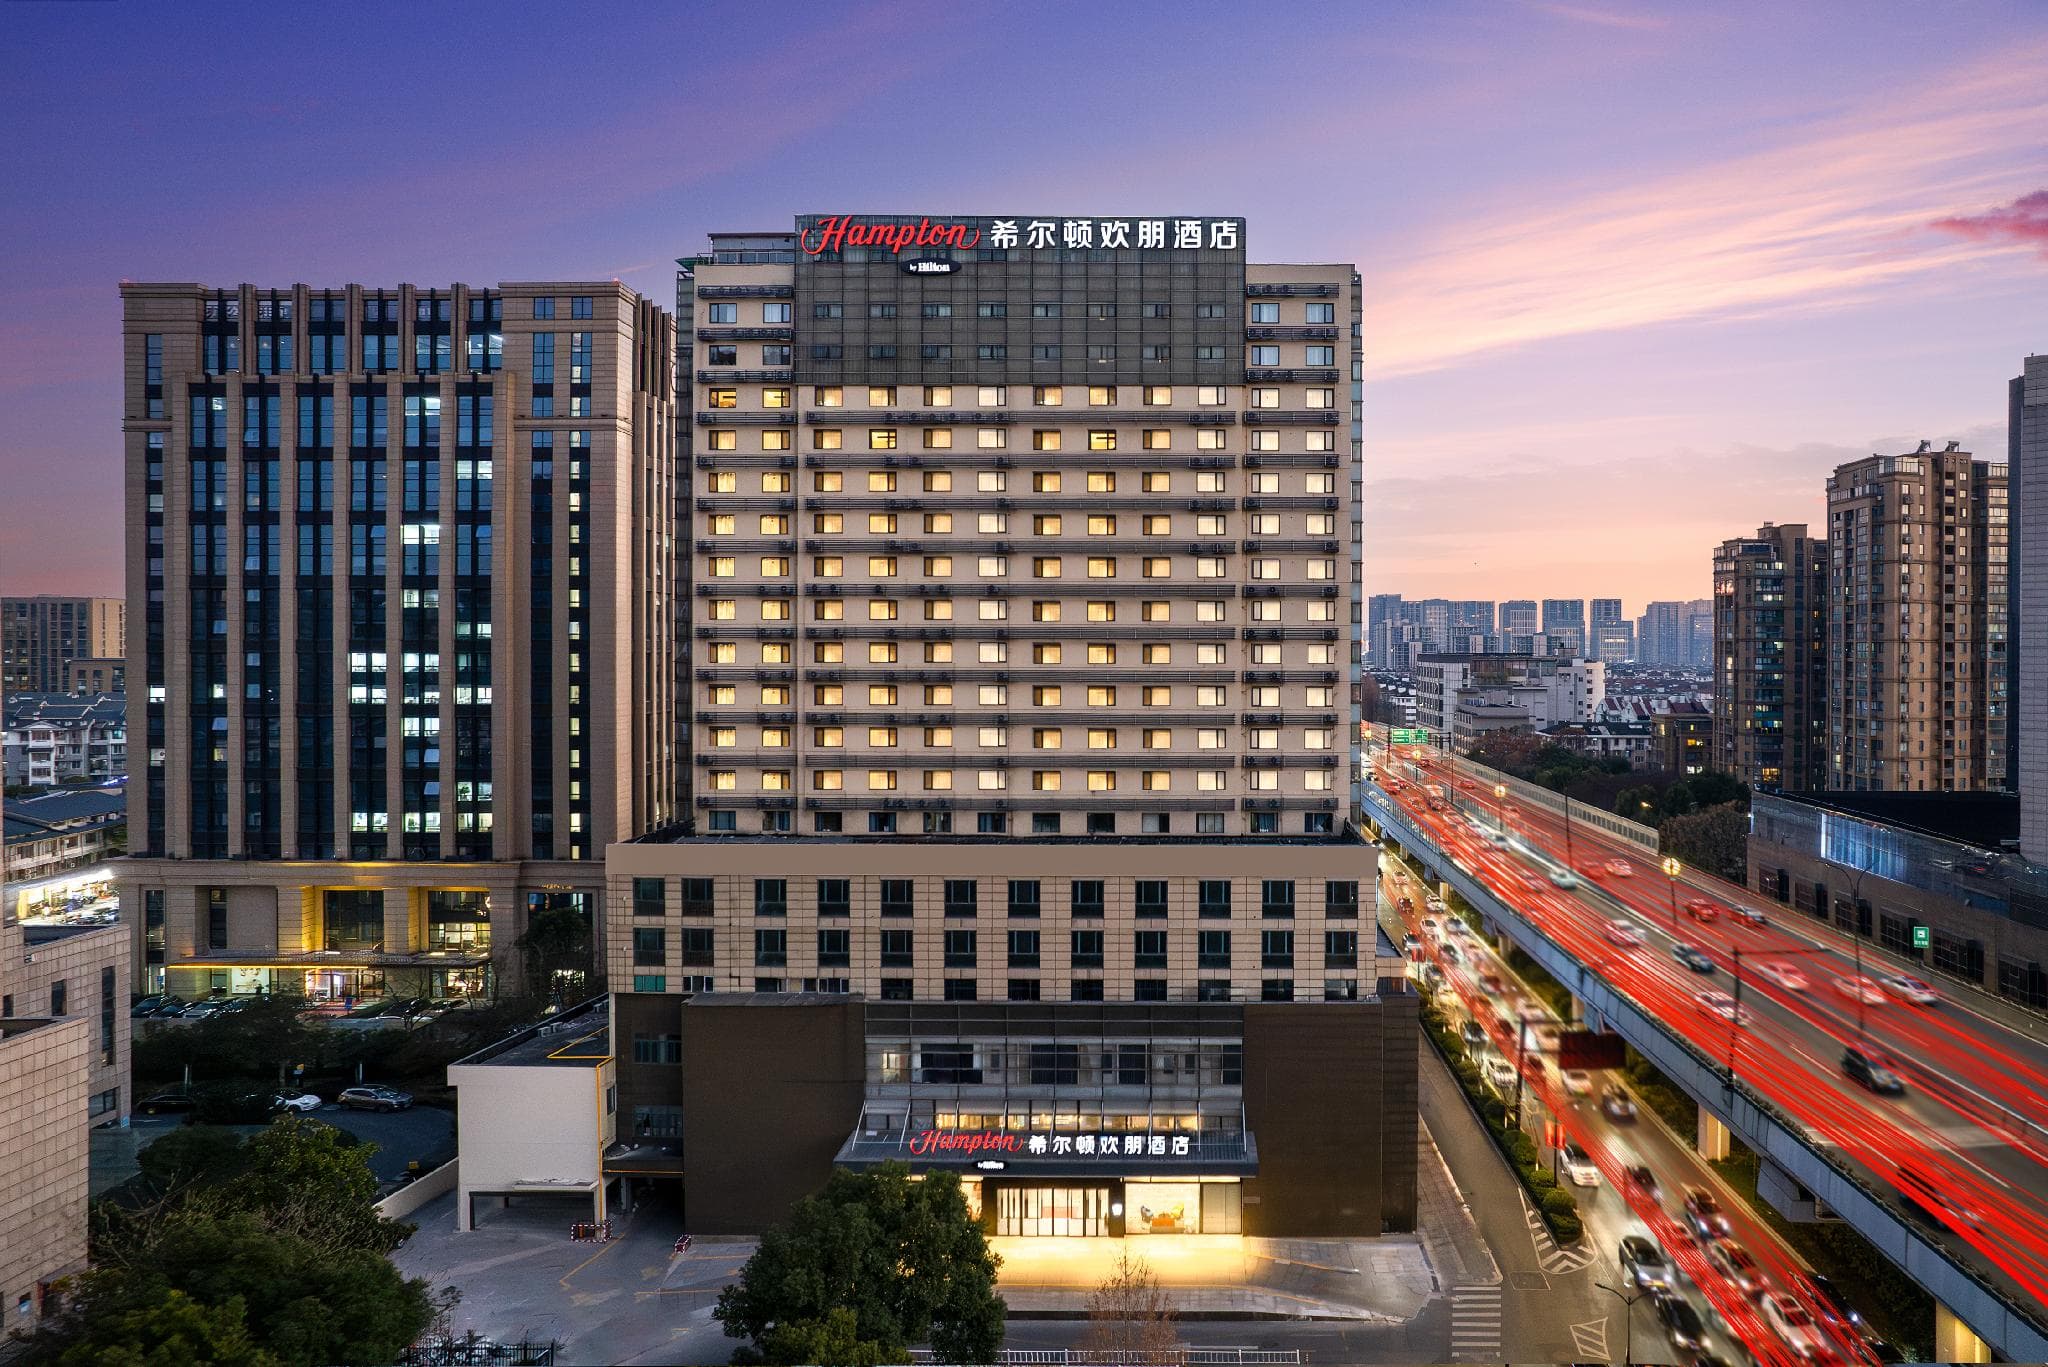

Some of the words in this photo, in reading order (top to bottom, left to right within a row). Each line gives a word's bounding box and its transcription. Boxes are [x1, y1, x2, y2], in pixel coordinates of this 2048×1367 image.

[801, 215, 981, 255] Hampton
[990, 220, 1239, 250] 希尔顿欢朋酒店
[918, 261, 951, 272] Hilton
[909, 1128, 1025, 1156] Hampton
[1028, 1135, 1190, 1155] 希尔顿欢朋酒店
